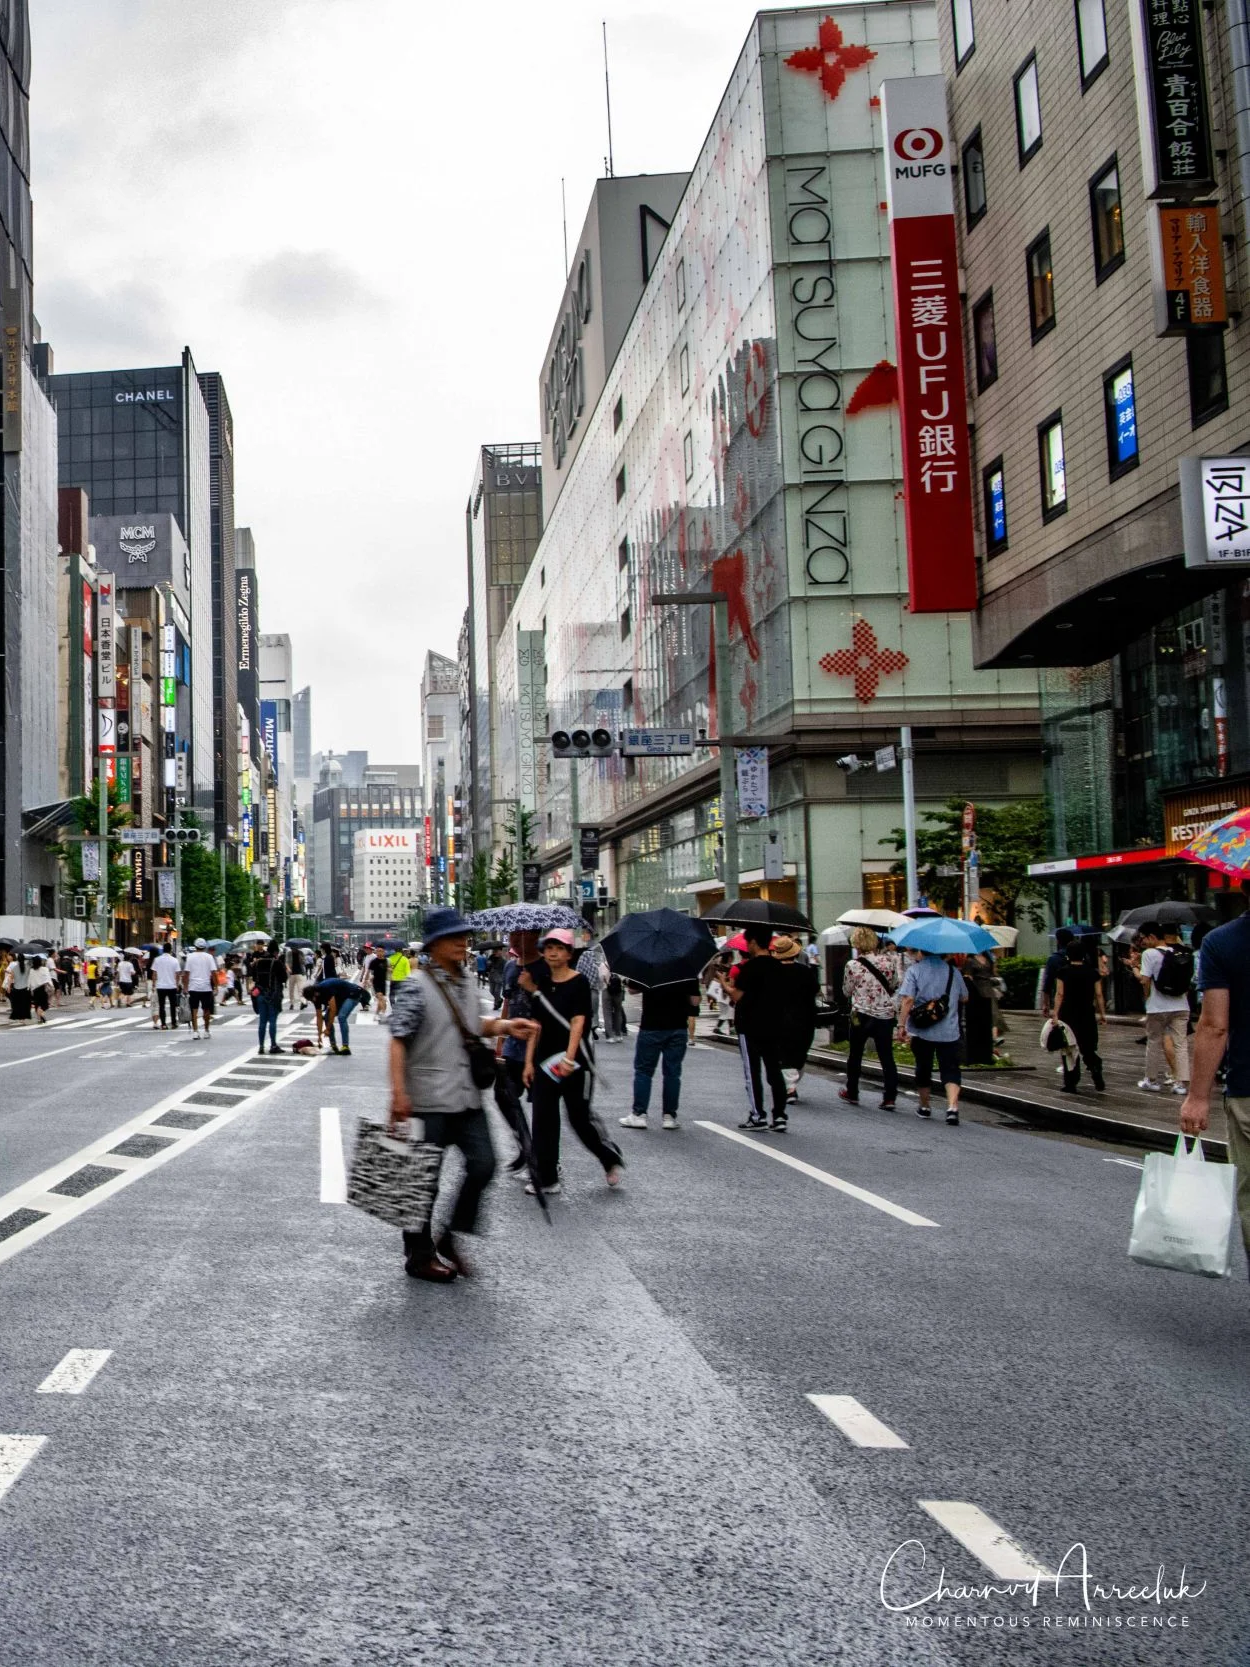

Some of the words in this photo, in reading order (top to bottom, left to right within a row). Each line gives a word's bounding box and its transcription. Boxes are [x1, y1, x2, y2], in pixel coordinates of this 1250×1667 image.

[894, 163, 947, 181] MUFG
[1186, 211, 1214, 318] 輸入洋食器
[910, 258, 958, 495] 三菱UFJ銀行
[115, 389, 175, 403] CHANEL
[119, 525, 156, 541] MCM
[238, 575, 252, 607] Zegna
[100, 617, 112, 685] 日本香堂ビル
[238, 607, 252, 671] Ermenegildo
[628, 733, 690, 746] 銀座三丁目
[369, 834, 409, 848] LIXIL
[134, 851, 144, 901] CHAUMET
